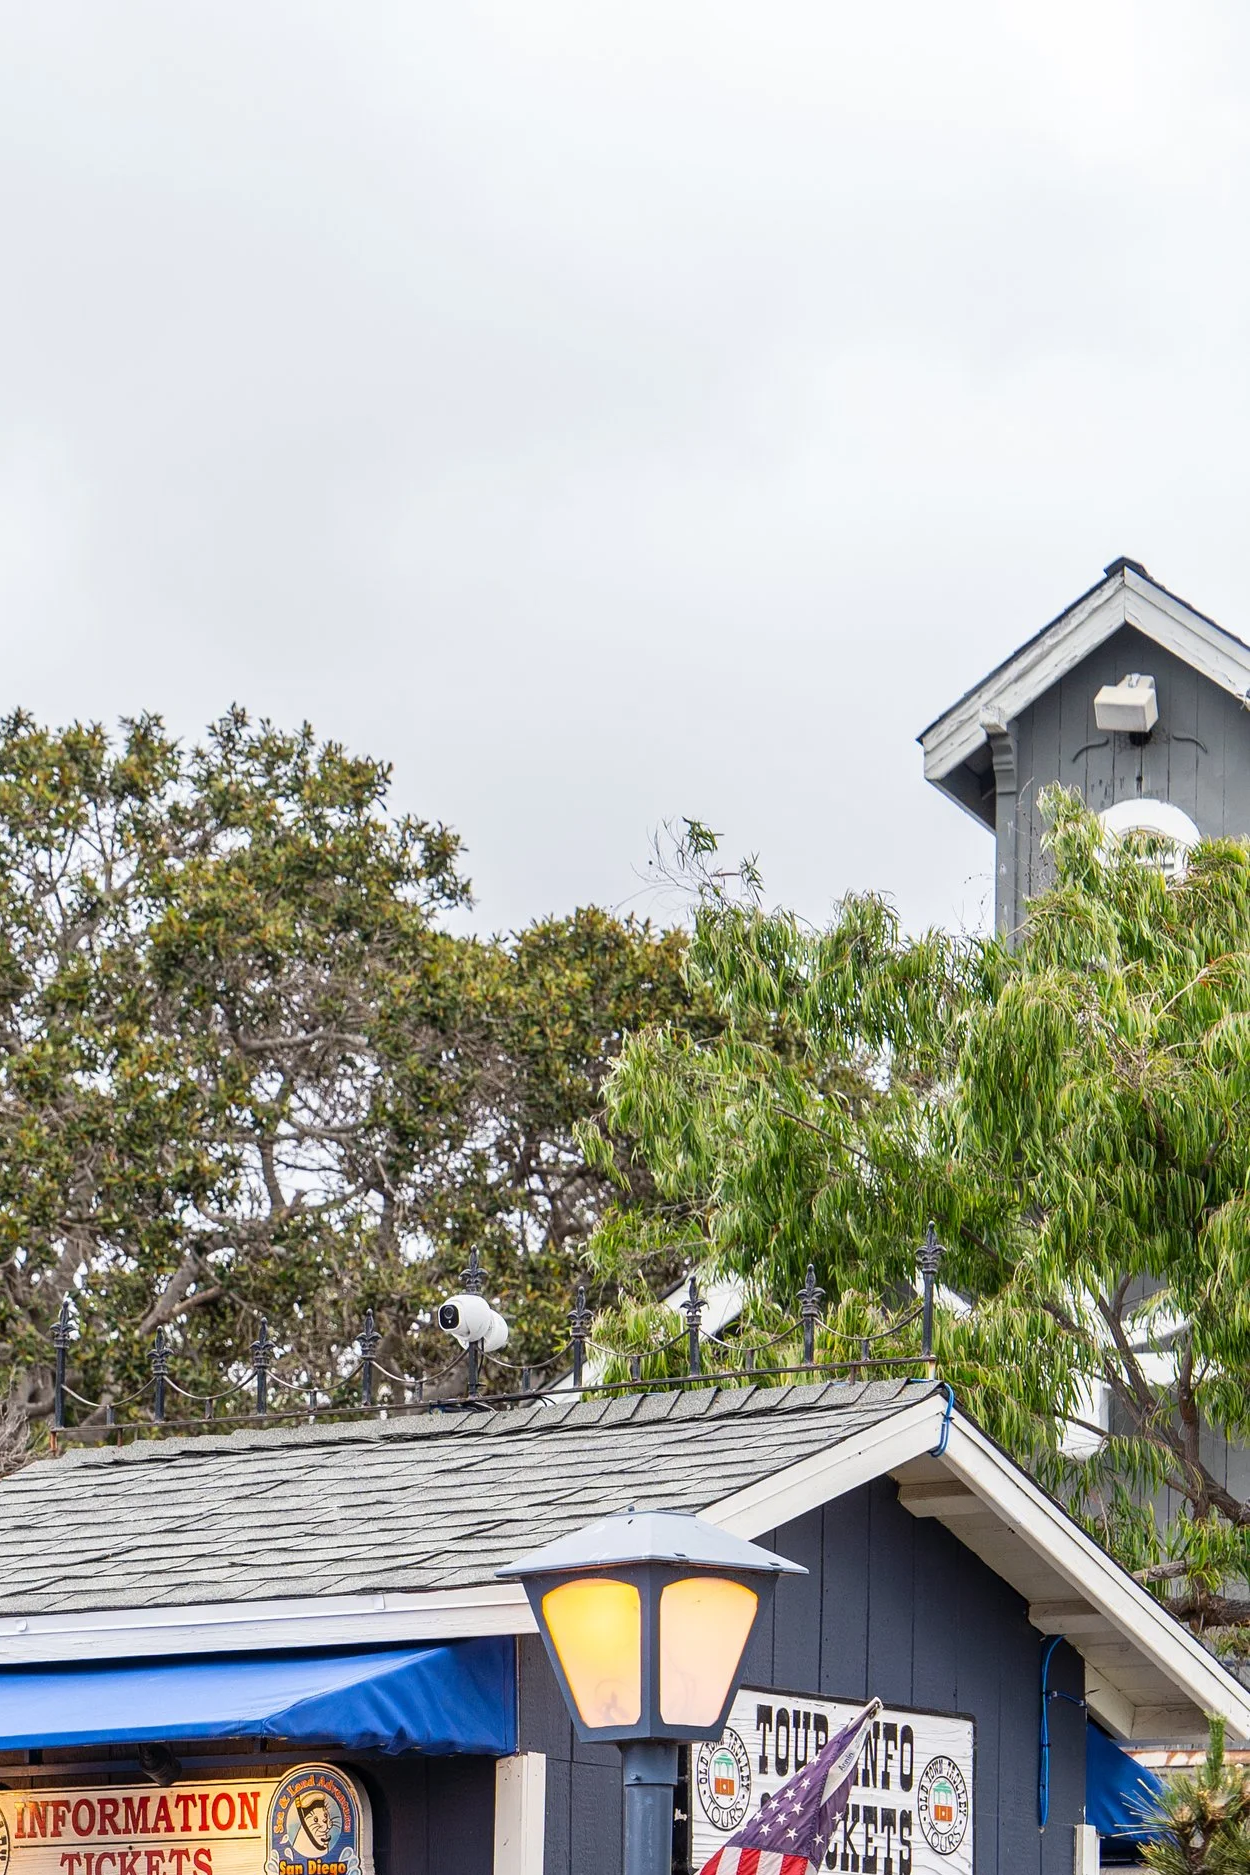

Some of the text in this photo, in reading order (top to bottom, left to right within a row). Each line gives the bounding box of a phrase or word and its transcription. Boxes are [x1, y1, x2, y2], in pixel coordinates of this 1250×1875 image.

[700, 1756, 708, 1784] OLD
[728, 1732, 750, 1791] TROLLEY
[851, 1717, 914, 1792] NFO
[287, 1774, 315, 1796] Land
[920, 1759, 967, 1817] OLD TOWN TROLLEY
[14, 1791, 261, 1839] INFORMATION
[707, 1795, 744, 1828] TOURS
[927, 1822, 961, 1852] TOURS
